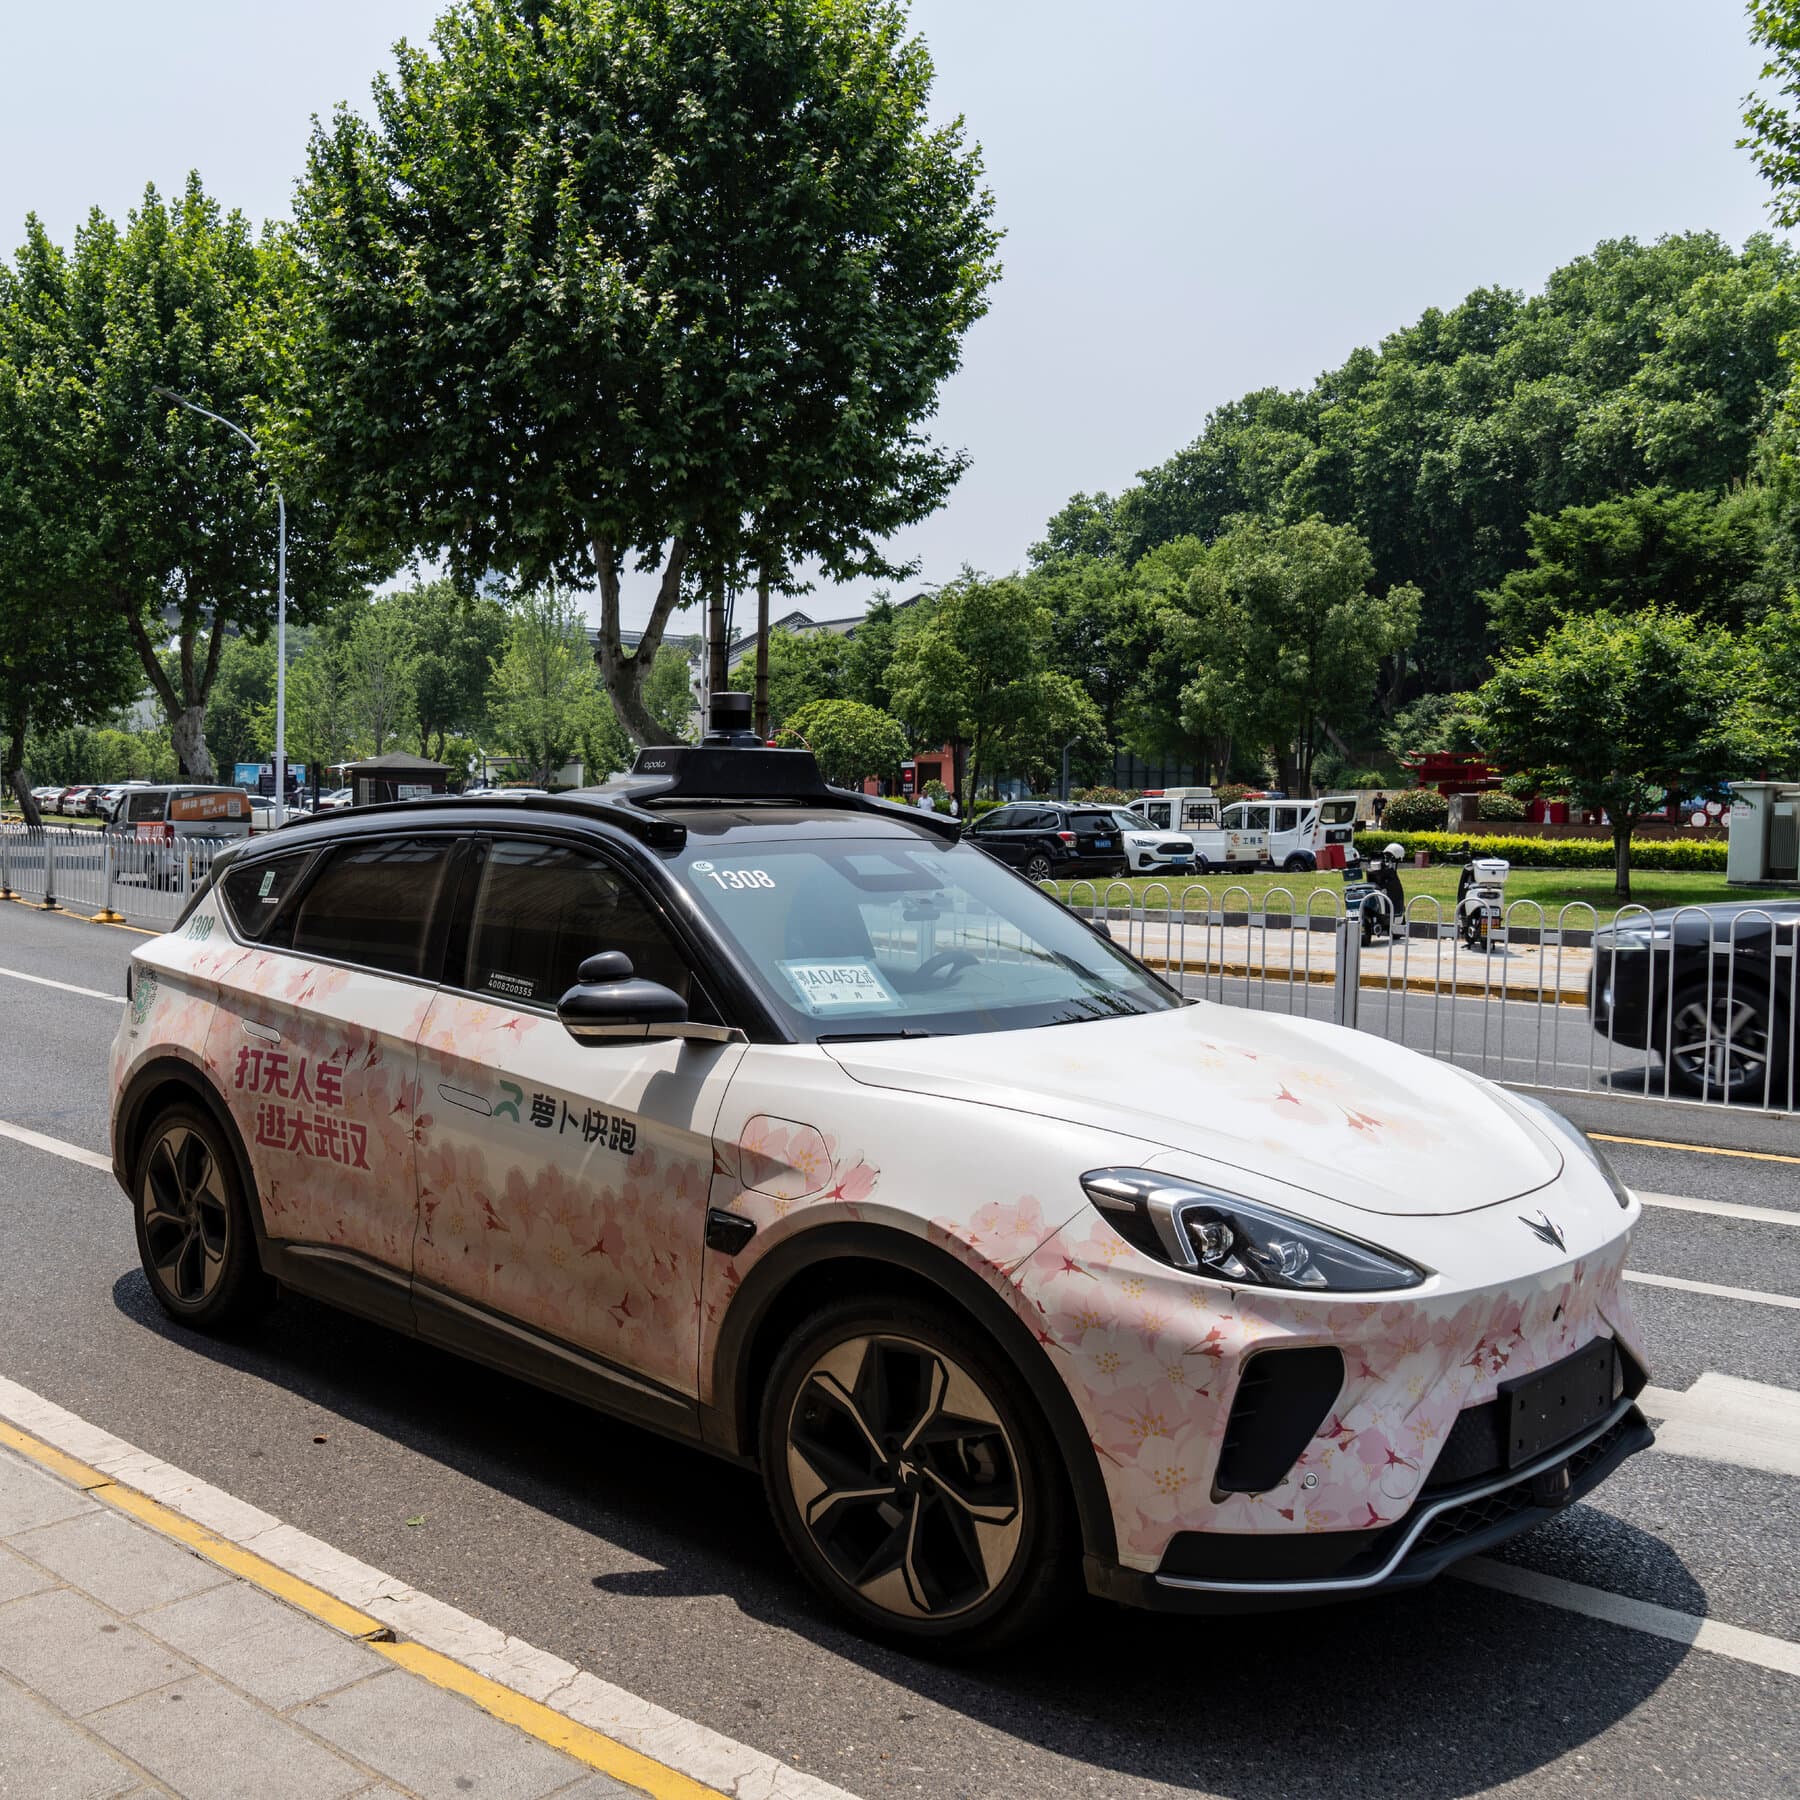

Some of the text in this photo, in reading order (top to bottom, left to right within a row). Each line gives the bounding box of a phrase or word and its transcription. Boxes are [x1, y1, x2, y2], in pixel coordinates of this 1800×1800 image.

[1242, 836, 1264, 845] 工程车
[708, 870, 776, 890] 1308
[186, 914, 215, 939] 1308
[488, 979, 533, 997] 4008200355
[235, 1045, 343, 1108] 打无人车
[255, 1102, 371, 1171] 逛大武汉
[529, 1092, 637, 1156] 萝卜快跑
